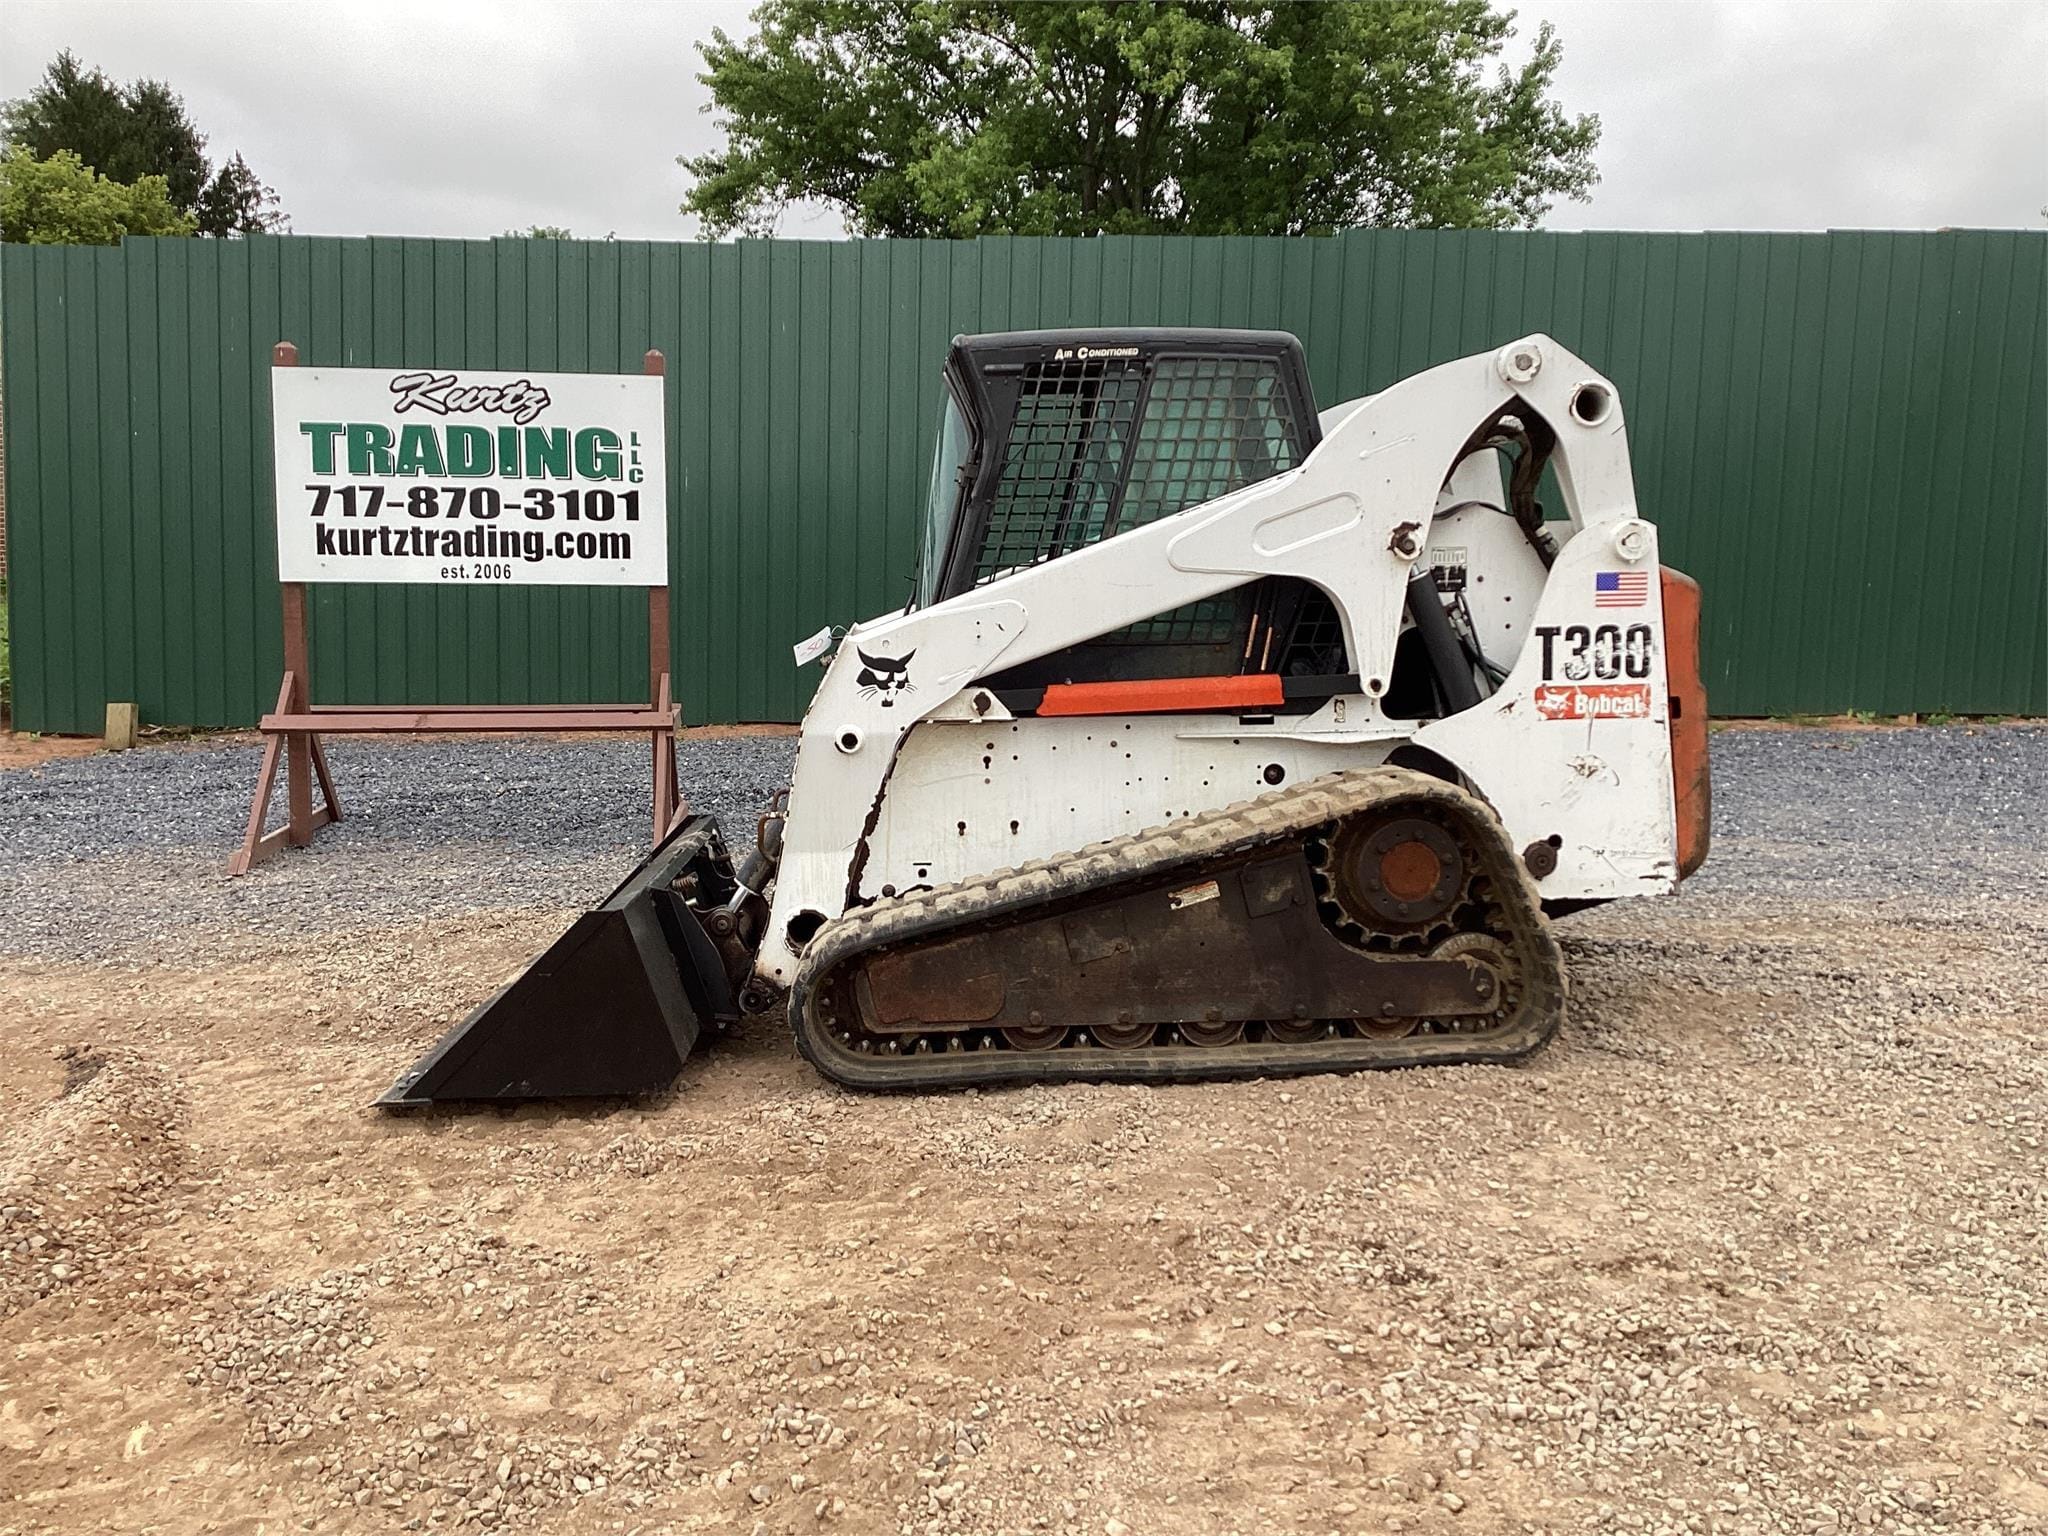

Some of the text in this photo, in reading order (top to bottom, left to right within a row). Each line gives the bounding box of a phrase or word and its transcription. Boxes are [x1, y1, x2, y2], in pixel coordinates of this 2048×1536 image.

[1054, 346, 1139, 360] AIR CONDITIONED
[390, 372, 551, 424] Kurtz
[300, 422, 644, 484] TRADING LLC
[305, 485, 640, 521] 717-870-3101
[315, 522, 631, 562] kurtztrading.com
[440, 565, 512, 581] est. 2006
[1535, 624, 1651, 680] T300
[1574, 693, 1643, 714] Bobcat
